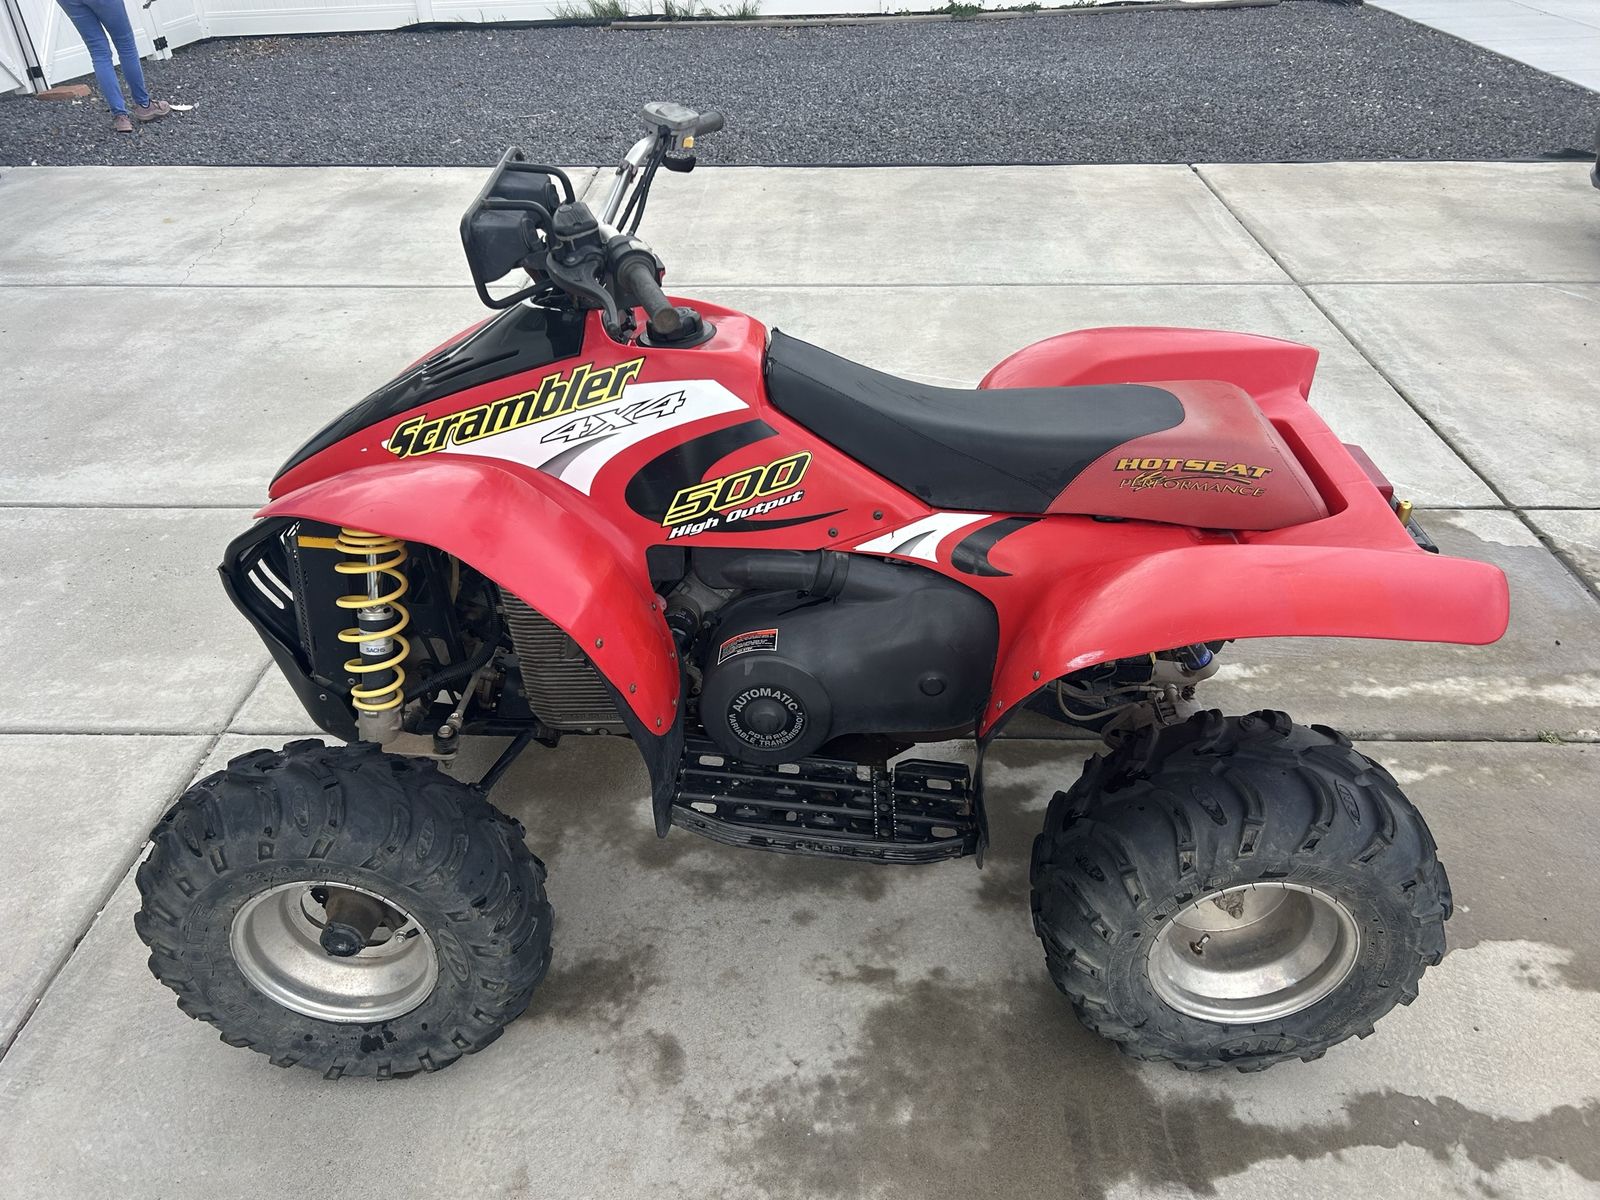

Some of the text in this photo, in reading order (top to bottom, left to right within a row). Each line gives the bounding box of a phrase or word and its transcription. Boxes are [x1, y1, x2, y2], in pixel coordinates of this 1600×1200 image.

[388, 357, 645, 459] Scrambler
[662, 451, 813, 527] 500
[1119, 477, 1265, 498] PERFORMANCE
[666, 491, 804, 541] High Output
[732, 687, 798, 713] AUTOMATIC
[728, 713, 756, 744] VARIABLE
[747, 730, 788, 741] POLARIS
